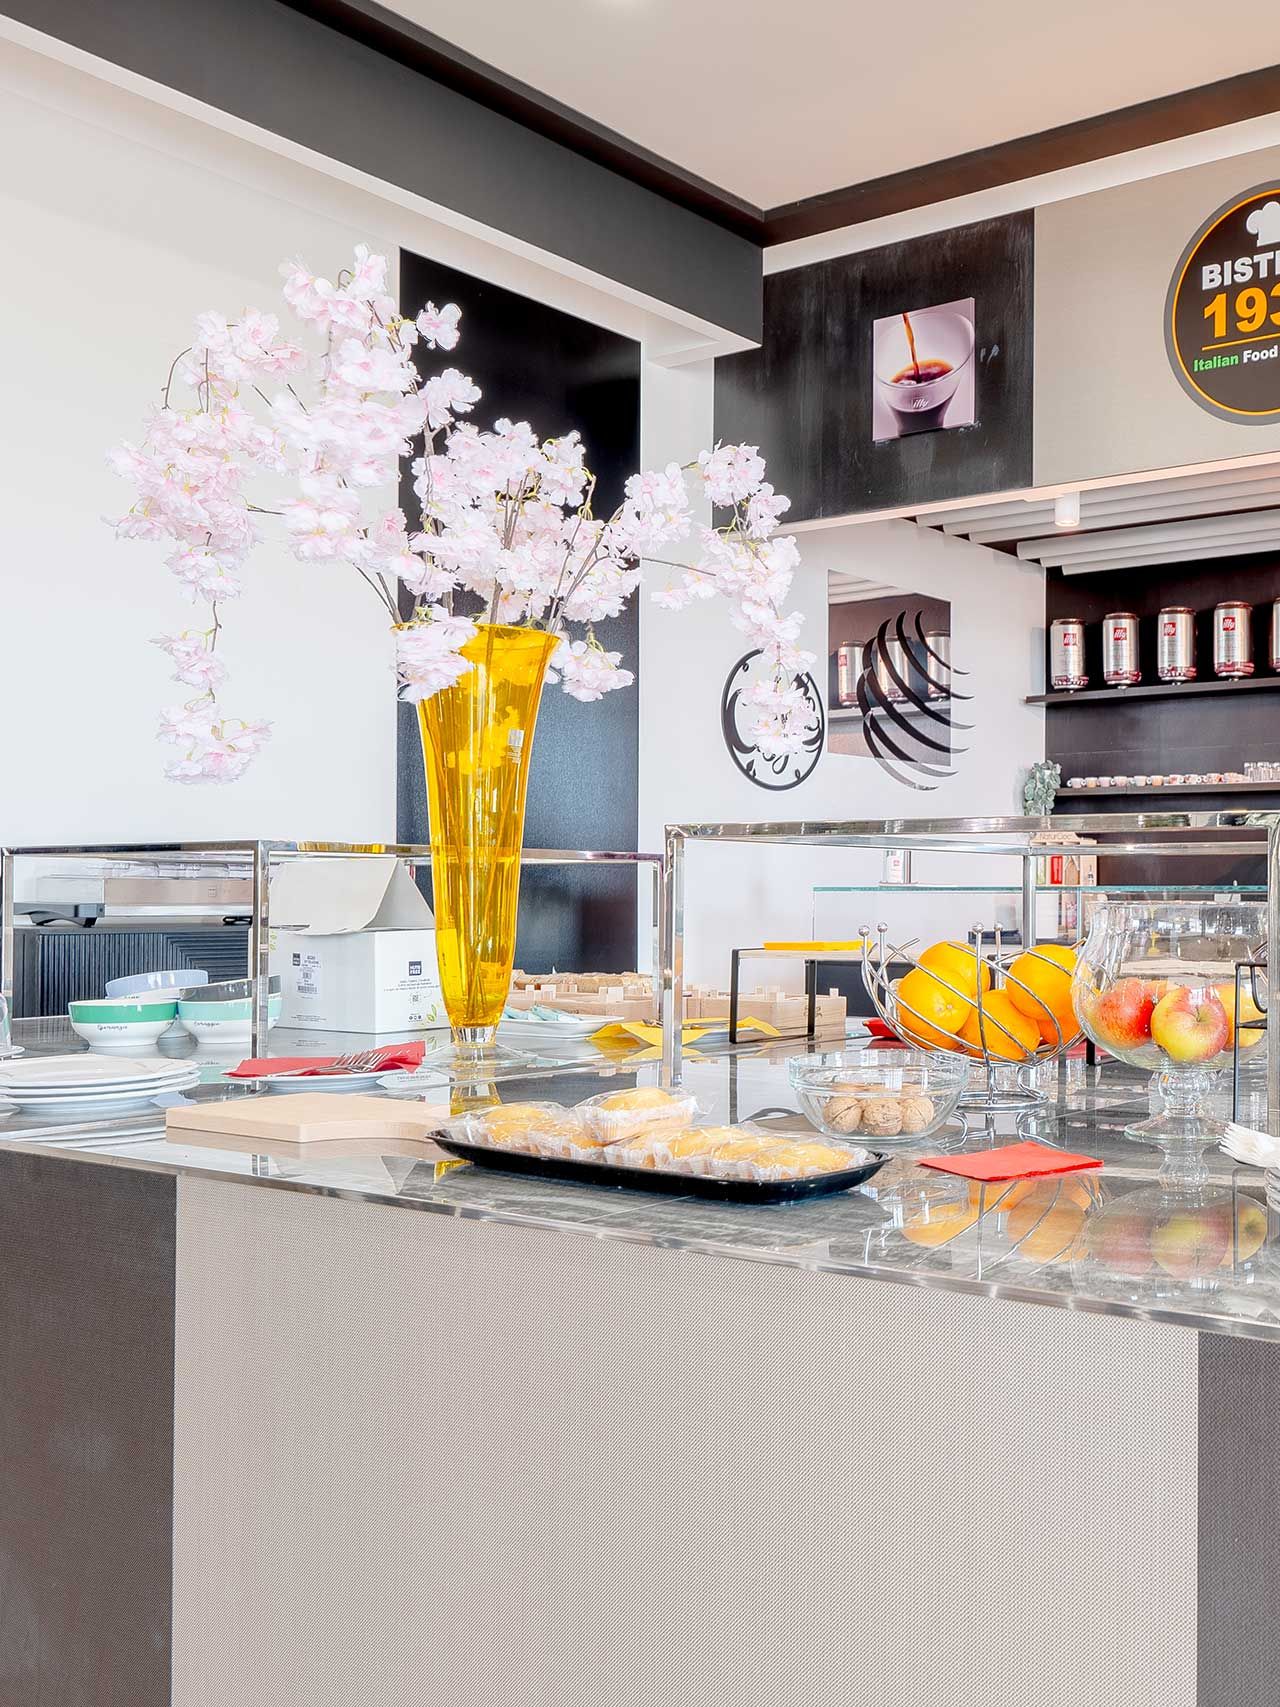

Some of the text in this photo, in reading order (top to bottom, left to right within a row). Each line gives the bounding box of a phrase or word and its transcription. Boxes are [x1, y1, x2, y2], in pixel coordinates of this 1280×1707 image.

[1193, 353, 1239, 372] Italian
[1243, 345, 1278, 364] Food
[913, 398, 929, 409] illy
